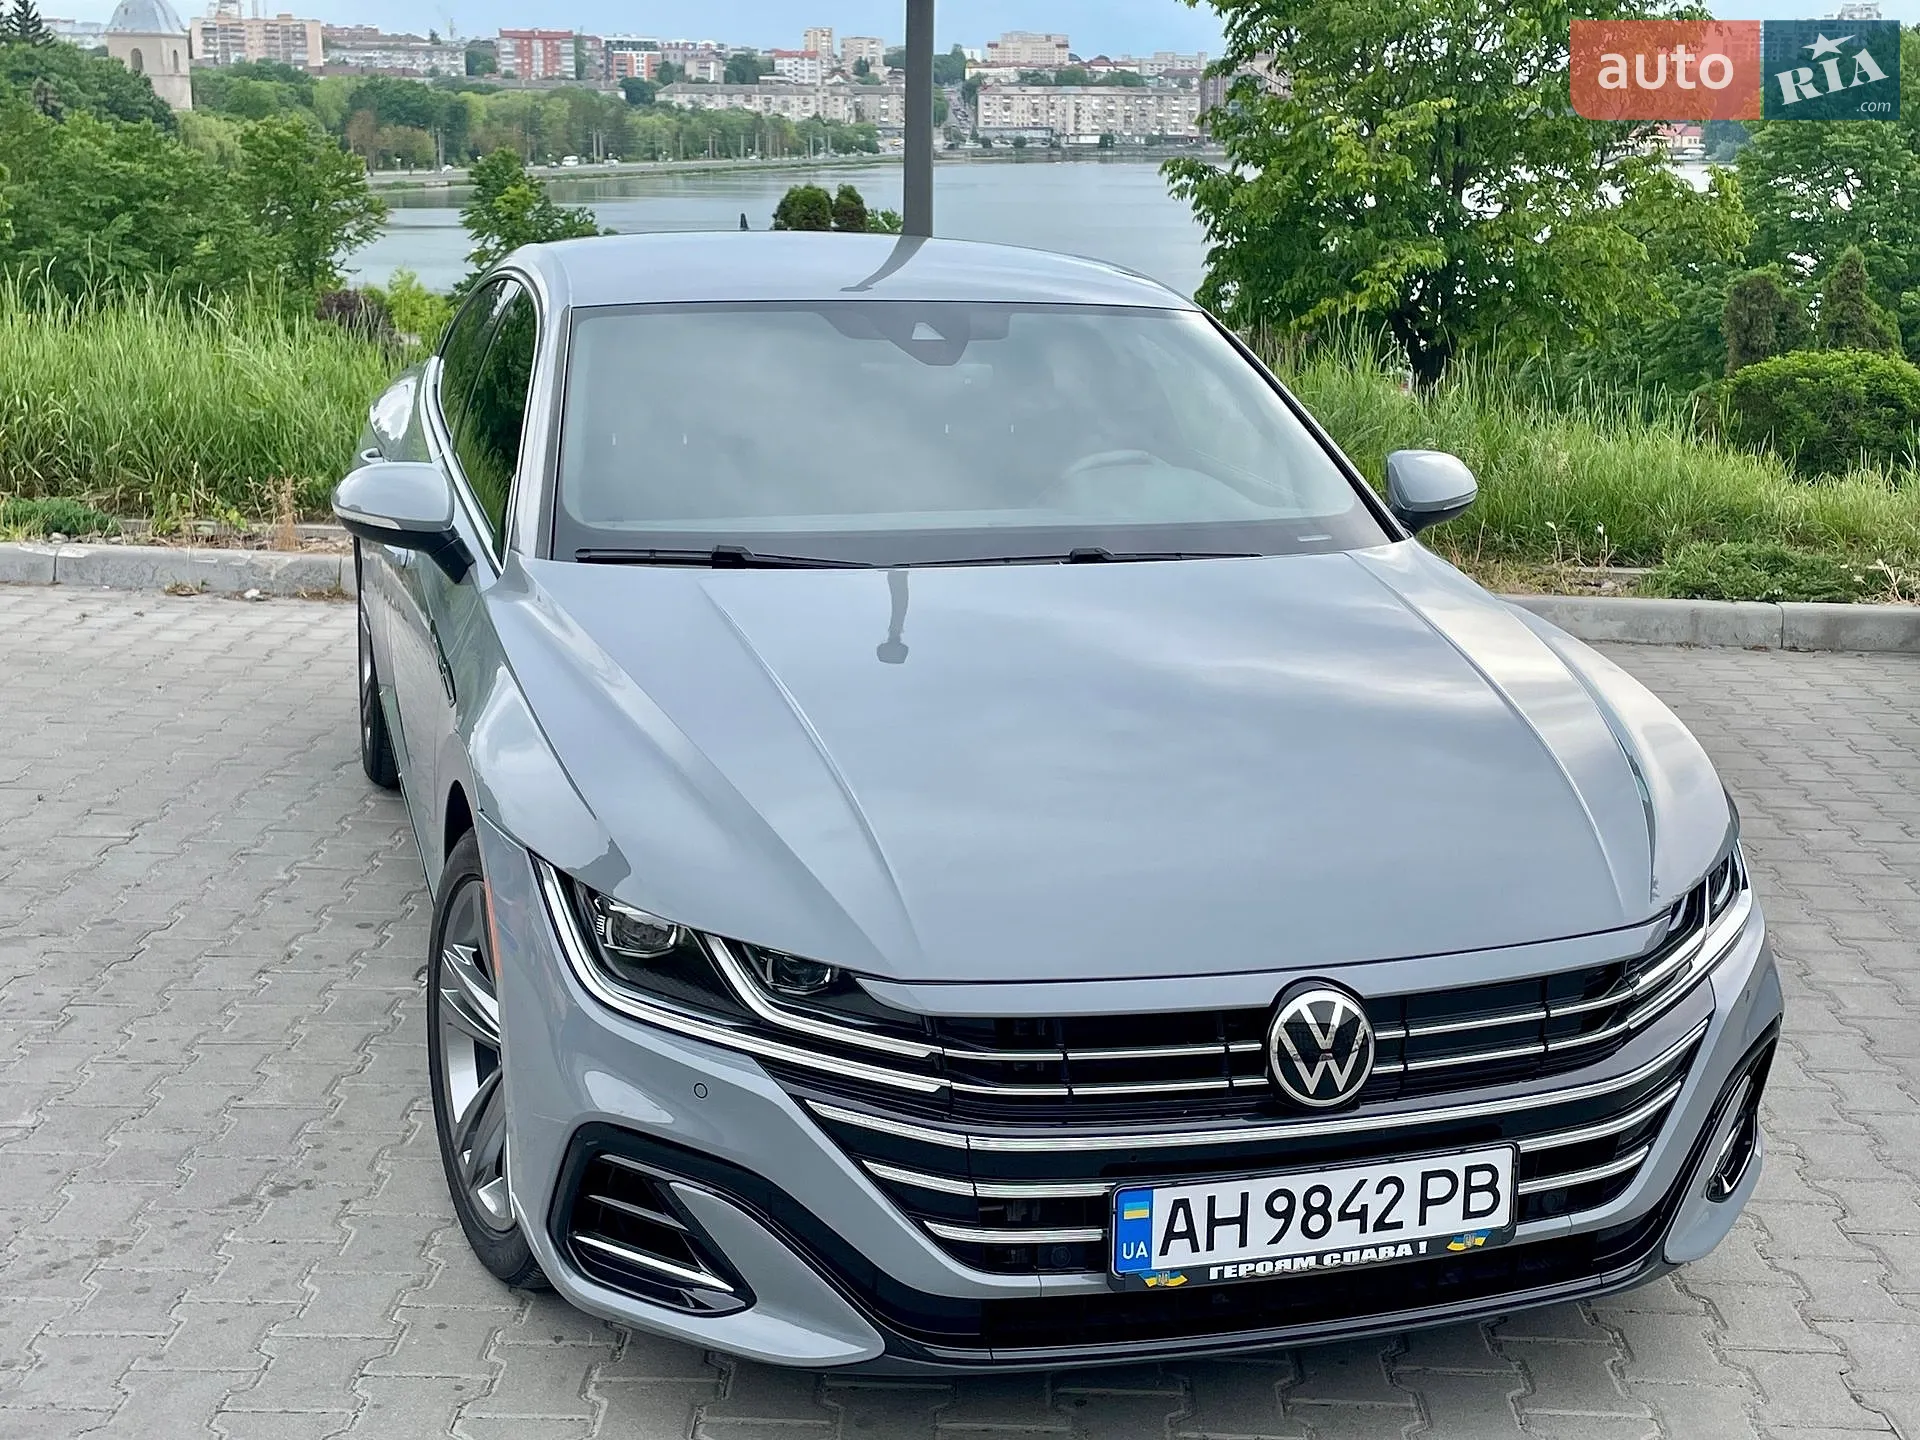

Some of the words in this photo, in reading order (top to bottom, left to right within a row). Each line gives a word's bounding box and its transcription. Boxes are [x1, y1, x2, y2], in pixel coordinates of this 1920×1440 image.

[1159, 1191, 1249, 1257] AH
[1265, 1175, 1404, 1245] 9842
[1419, 1163, 1501, 1227] PB
[1122, 1241, 1148, 1260] UA
[1209, 1255, 1318, 1281] ГЕРОЯМ
